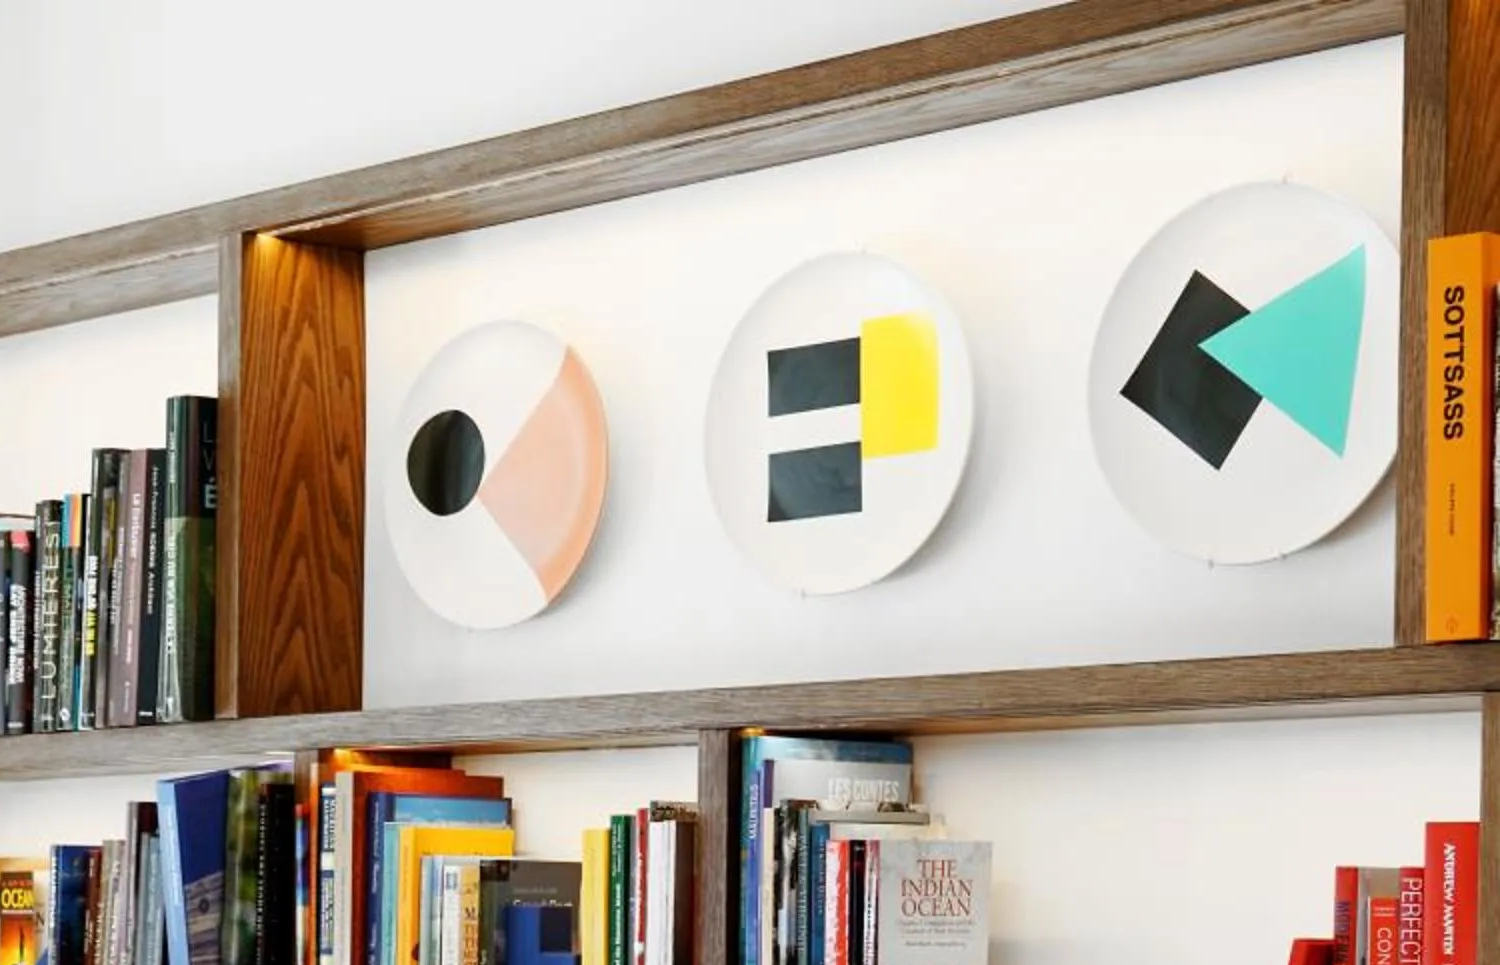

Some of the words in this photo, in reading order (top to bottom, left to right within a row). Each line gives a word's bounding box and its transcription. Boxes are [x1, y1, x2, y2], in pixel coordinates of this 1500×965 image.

[1443, 286, 1465, 441] SOTTSASS
[917, 859, 957, 878] THE
[1443, 844, 1457, 902] ANDREW
[901, 879, 973, 897] INDIAN
[901, 897, 971, 917] OCEAN
[1443, 904, 1455, 956] MARTIN
